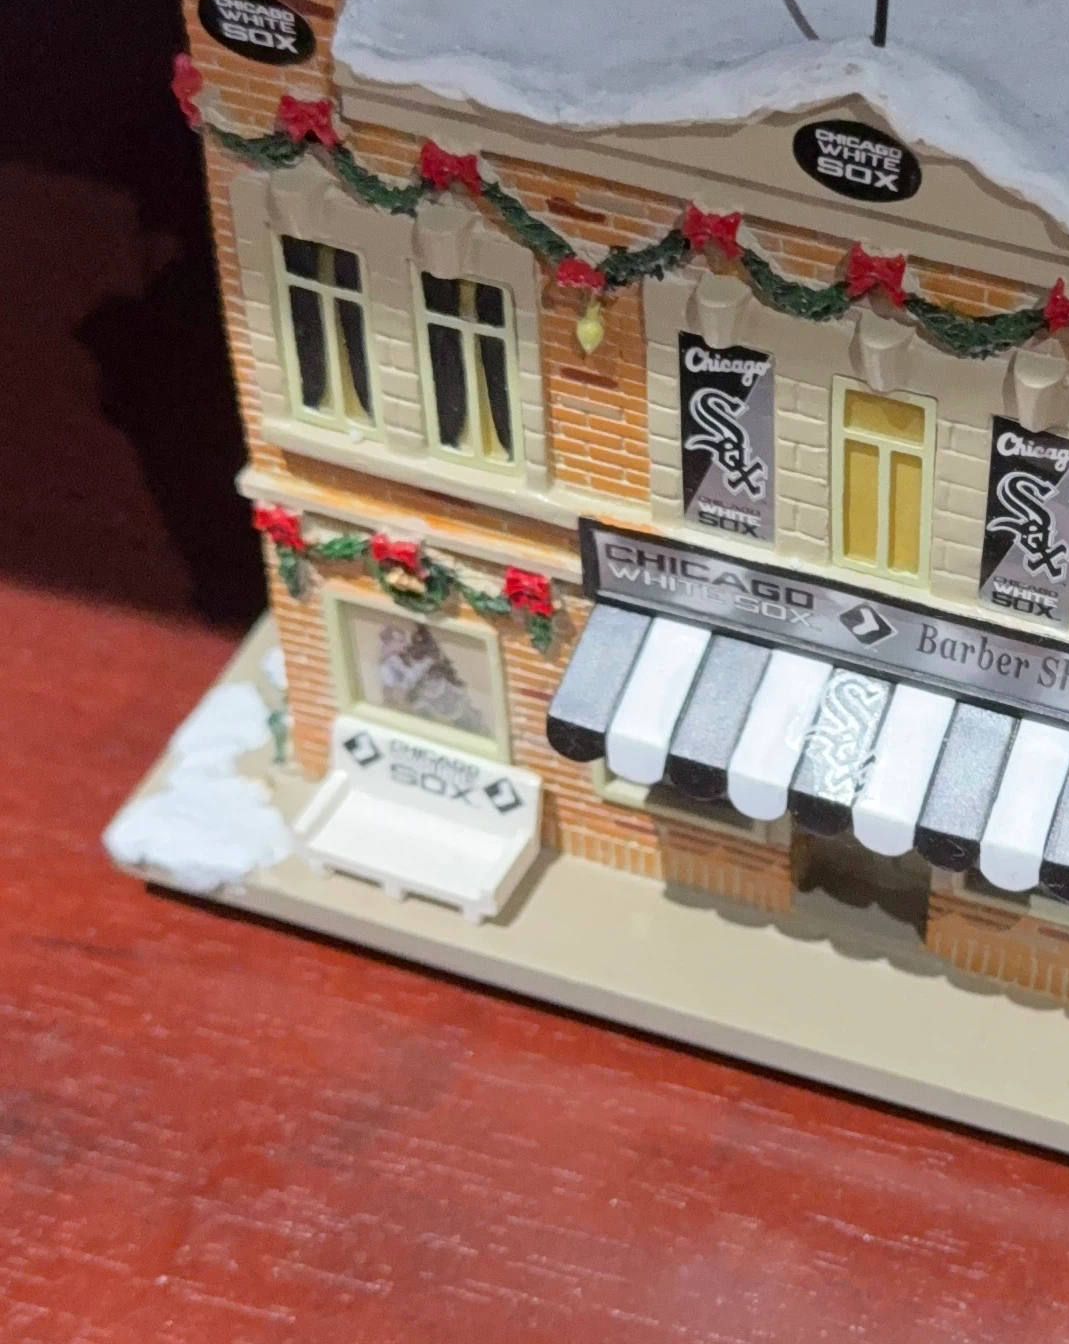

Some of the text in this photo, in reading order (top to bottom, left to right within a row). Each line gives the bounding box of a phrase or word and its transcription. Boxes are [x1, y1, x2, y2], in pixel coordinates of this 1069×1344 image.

[219, 6, 298, 35] WHITE
[221, 22, 299, 55] SOX
[815, 128, 903, 159] CHICAGO
[817, 140, 901, 173] WHITE
[816, 156, 899, 193] SOX
[685, 346, 771, 387] Chicago
[698, 501, 761, 527] WHITE
[698, 510, 758, 538] SOX
[604, 543, 815, 610] CHICAGO
[607, 561, 813, 628] WHITE SOX
[991, 590, 1053, 619] SOX
[993, 581, 1058, 609] WHITE
[916, 622, 1030, 679] Barber
[389, 762, 473, 805] SOX
